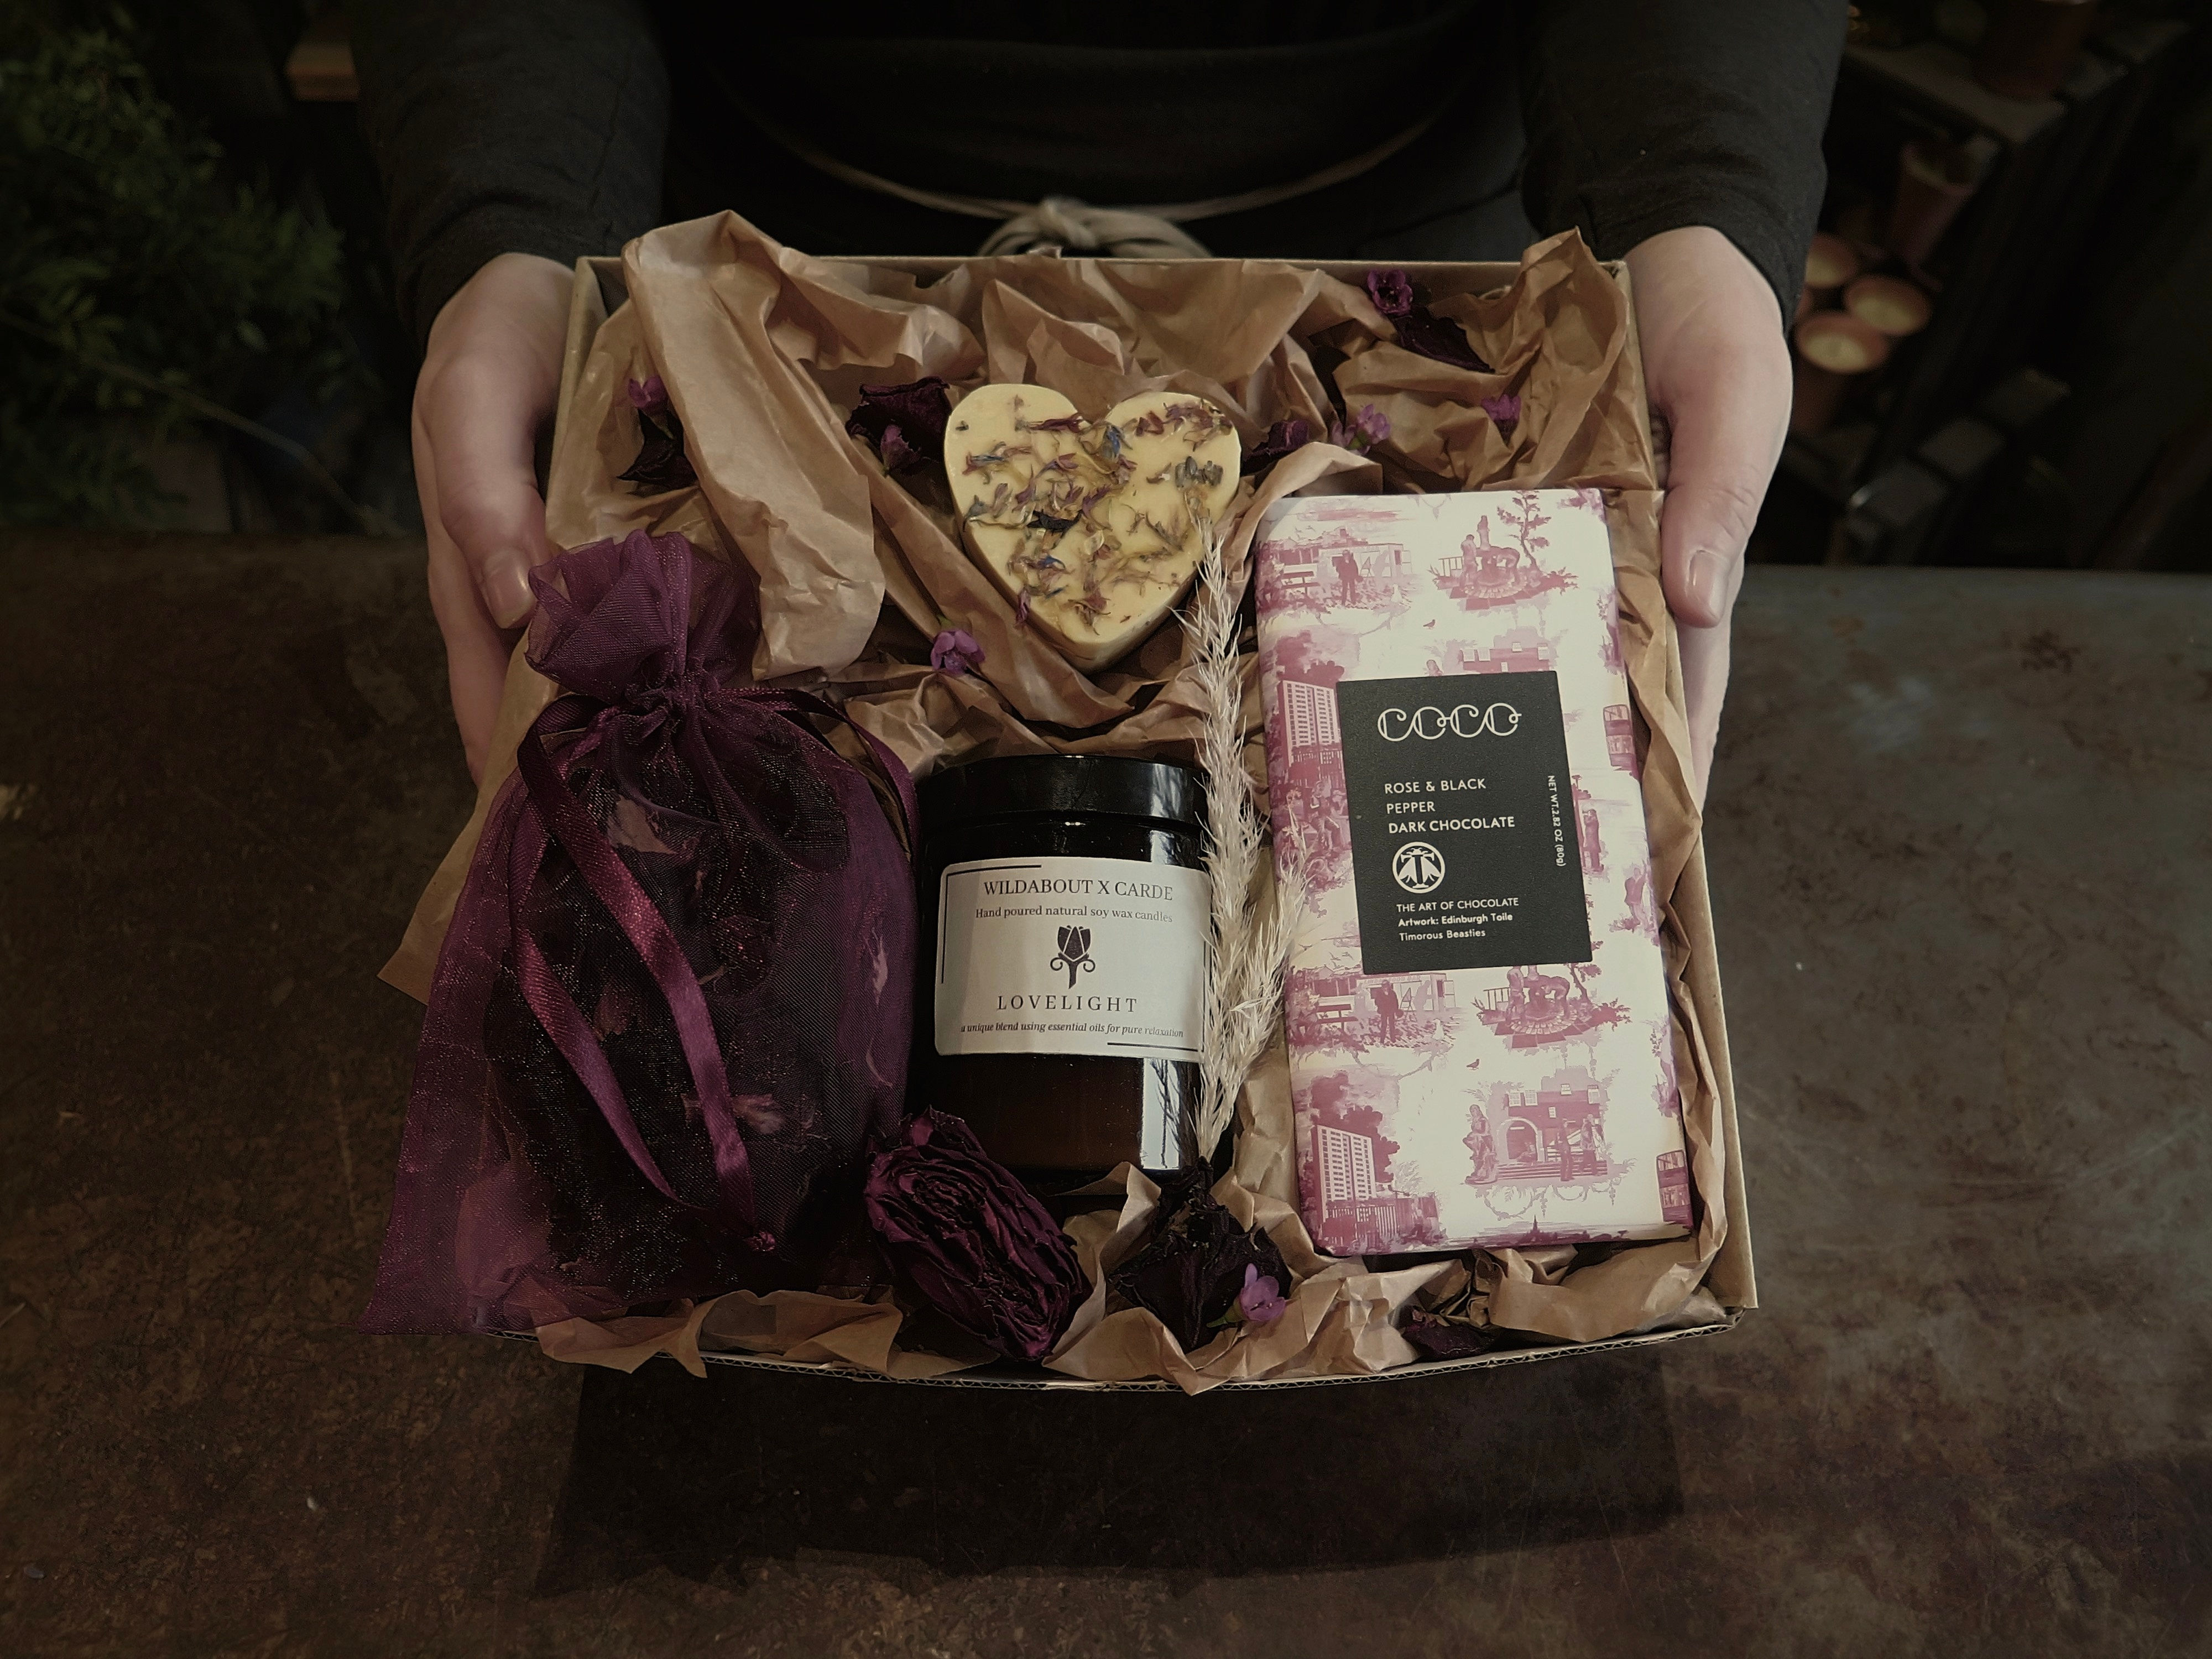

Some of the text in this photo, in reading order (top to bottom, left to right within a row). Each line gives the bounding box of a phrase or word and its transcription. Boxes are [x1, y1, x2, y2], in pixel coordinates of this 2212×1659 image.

[1378, 702, 1522, 742] COCO
[1384, 778, 1486, 794] ROSE & BLACK
[1548, 775, 1557, 792] NET
[1386, 801, 1436, 814] PEPPER
[1389, 816, 1515, 834] DARK CHOCOLATE
[1554, 829, 1563, 842] OZ
[1554, 844, 1567, 867] (80g)
[984, 879, 1173, 901] WILDABOUT X CARDE
[1396, 898, 1519, 912] THE ART OF CHOCOLATE
[975, 905, 1173, 922] Hand poured natural soy wax candles
[1398, 912, 1513, 927] Artwork: Edinburgh Toile
[1399, 928, 1486, 941] Timorous Beasties
[997, 995, 1137, 1013] LOVELIGHT
[967, 1023, 994, 1034] unique
[995, 1022, 1019, 1031] blend
[1021, 1022, 1046, 1033] using
[1048, 1022, 1087, 1032] essential
[1089, 1023, 1105, 1032] oils
[1105, 1024, 1121, 1034] for
[1121, 1026, 1142, 1035] pure
[1144, 1026, 1183, 1037] relaxation
